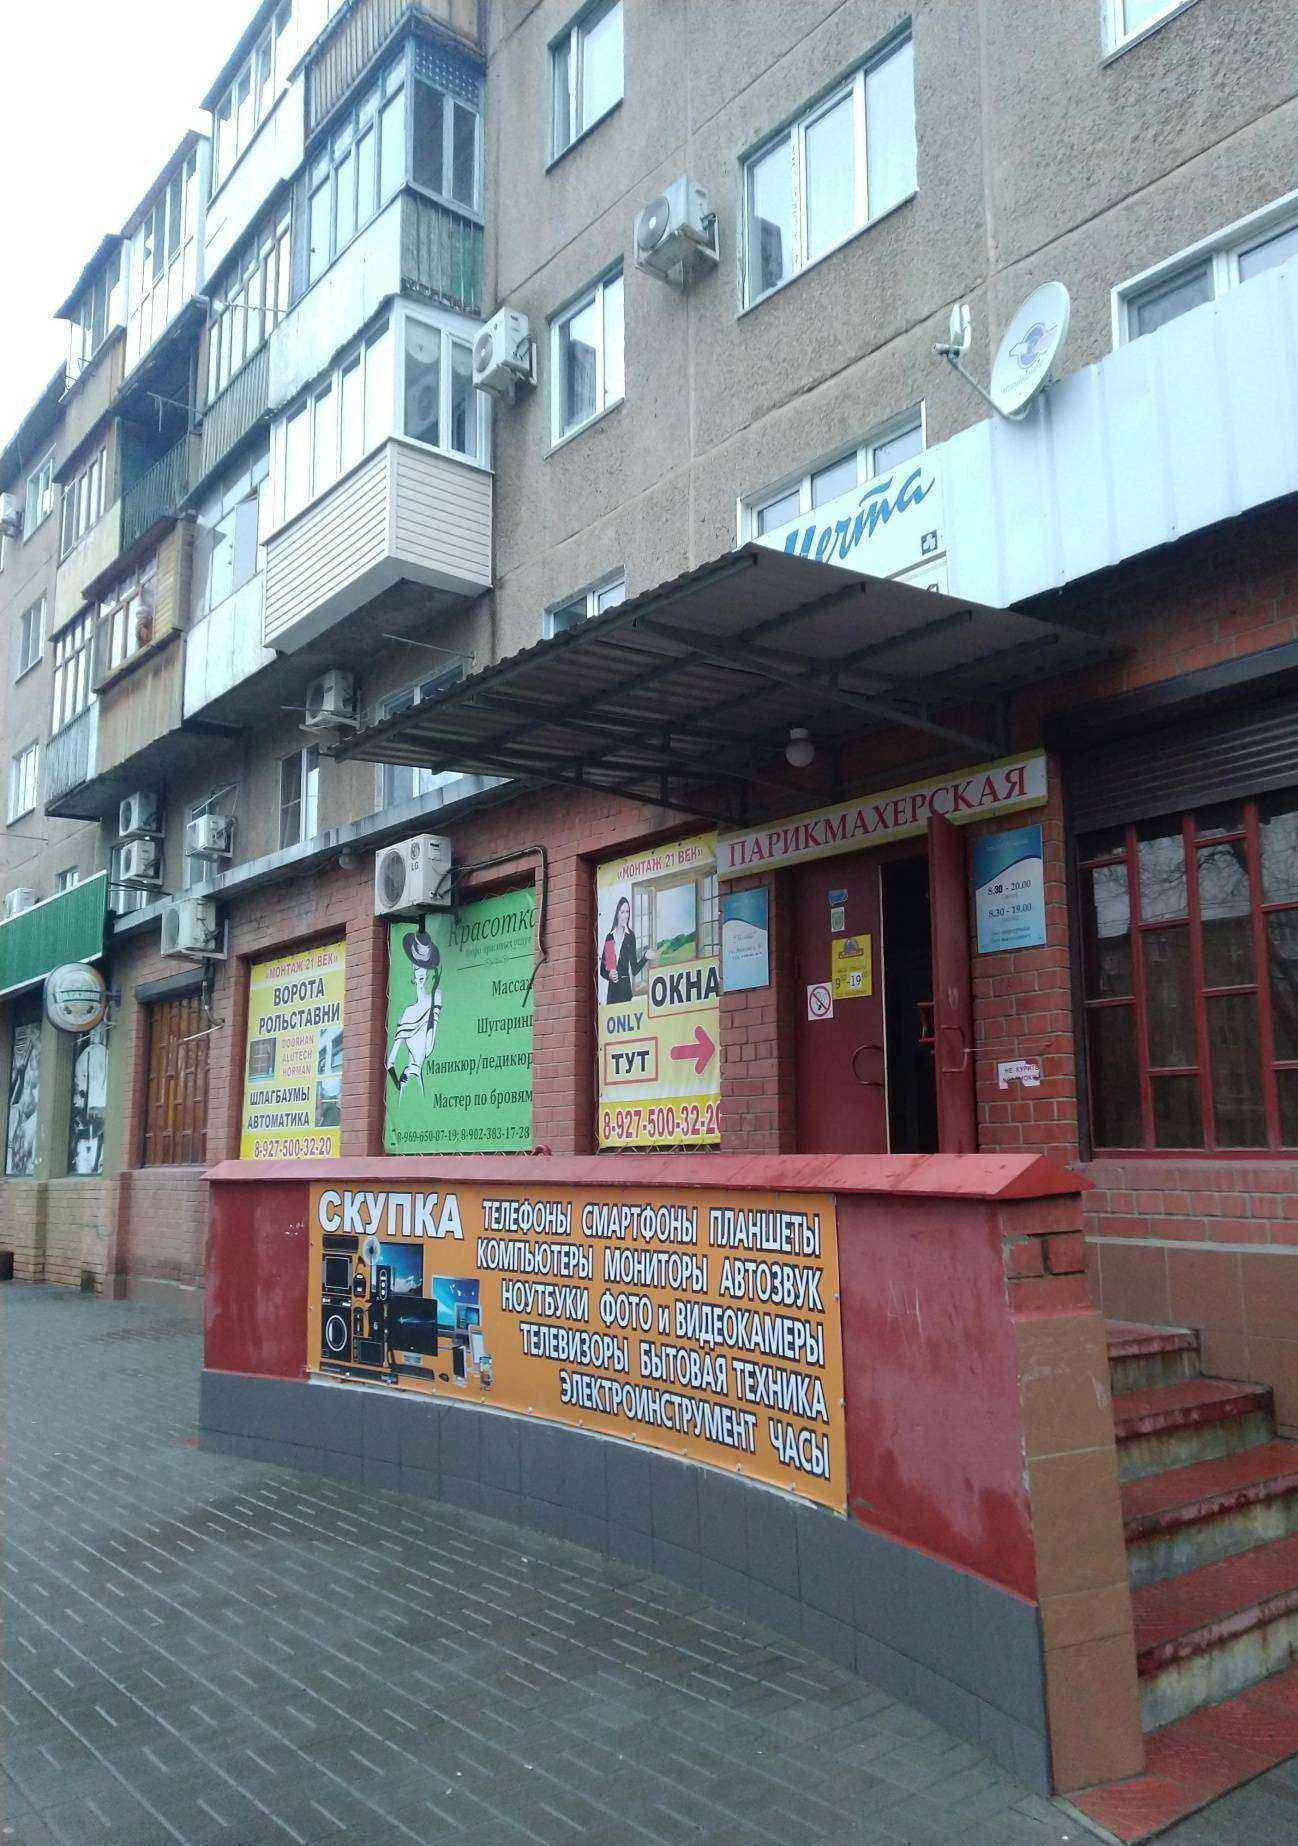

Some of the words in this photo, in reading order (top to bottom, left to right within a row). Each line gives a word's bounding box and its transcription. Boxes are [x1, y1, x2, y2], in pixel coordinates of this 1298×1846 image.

[728, 765, 1028, 868] ПАРИКМАХЕРСКАЯ
[665, 852, 675, 867] 21
[1011, 880, 1031, 891] 20.00
[1012, 903, 1032, 914] 19.00
[306, 958, 314, 970] 21
[274, 978, 325, 1007] ВОРОТА
[651, 967, 719, 1007] ОКНА
[258, 1002, 341, 1035] РОЛЬСТАВНИ
[606, 1012, 643, 1034] ONLY
[426, 1052, 533, 1076] Маникюр/педикюр
[611, 1050, 649, 1074] ТУТ
[250, 1086, 310, 1106] ШЛАГБАУМЫ
[433, 1093, 471, 1111] Мастер
[474, 1092, 487, 1106] по
[248, 1111, 310, 1130] АВТОМАТИКА
[254, 1136, 332, 1158] 8-927-500-32-20
[318, 1190, 465, 1240] СКУПКА
[483, 1199, 572, 1236] ТЕЛЕФОНЫ
[582, 1204, 698, 1244] СМАРТФОНЫ
[709, 1207, 821, 1257] ПЛАНШЕТЫ
[476, 1238, 593, 1279] КОМПЬЮТЕРЫ
[604, 1247, 708, 1293] МОНИТОРЫ
[720, 1258, 825, 1313] АВТОЗВУК
[501, 1278, 589, 1321] НОУТБУКИ
[600, 1291, 652, 1331] ФОТО
[658, 1306, 670, 1334] и
[675, 1300, 825, 1368] ВИДЕОКАМЕРЫ
[520, 1323, 629, 1373] ТЕЛЕВИЗОРЫ
[640, 1342, 728, 1395] БЫТОВАЯ
[733, 1359, 829, 1424] ТЕХНИКА
[560, 1370, 758, 1452] ЭЛЕКТРОИНСТРУМЕНТ
[768, 1418, 831, 1481] ЧАСЫ
